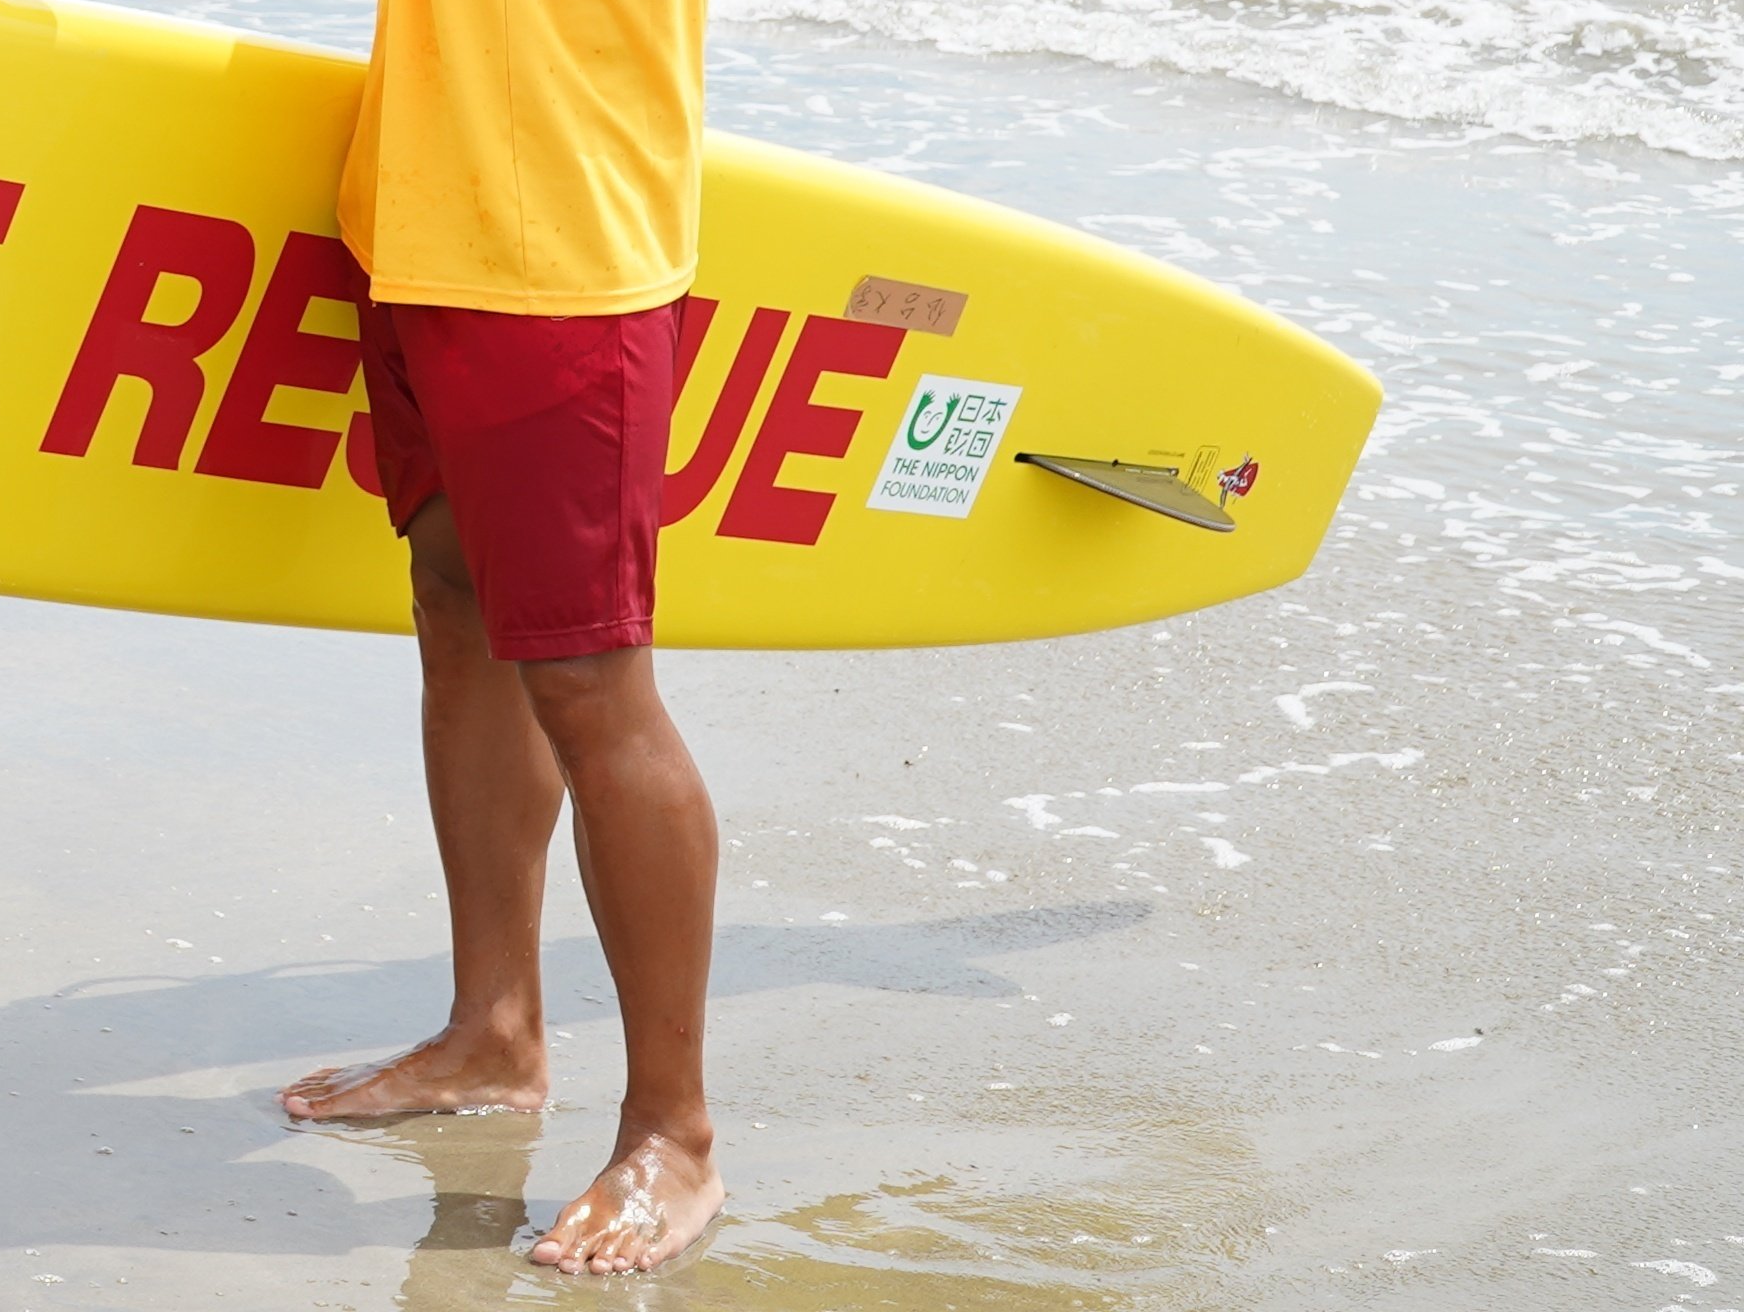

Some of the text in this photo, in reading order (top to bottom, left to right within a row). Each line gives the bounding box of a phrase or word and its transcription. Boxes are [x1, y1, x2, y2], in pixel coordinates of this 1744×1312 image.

[39, 203, 907, 545] REUE
[958, 394, 1007, 424] 日本
[891, 457, 979, 483] THE NIPPON
[880, 480, 970, 504] FOUNDATION
